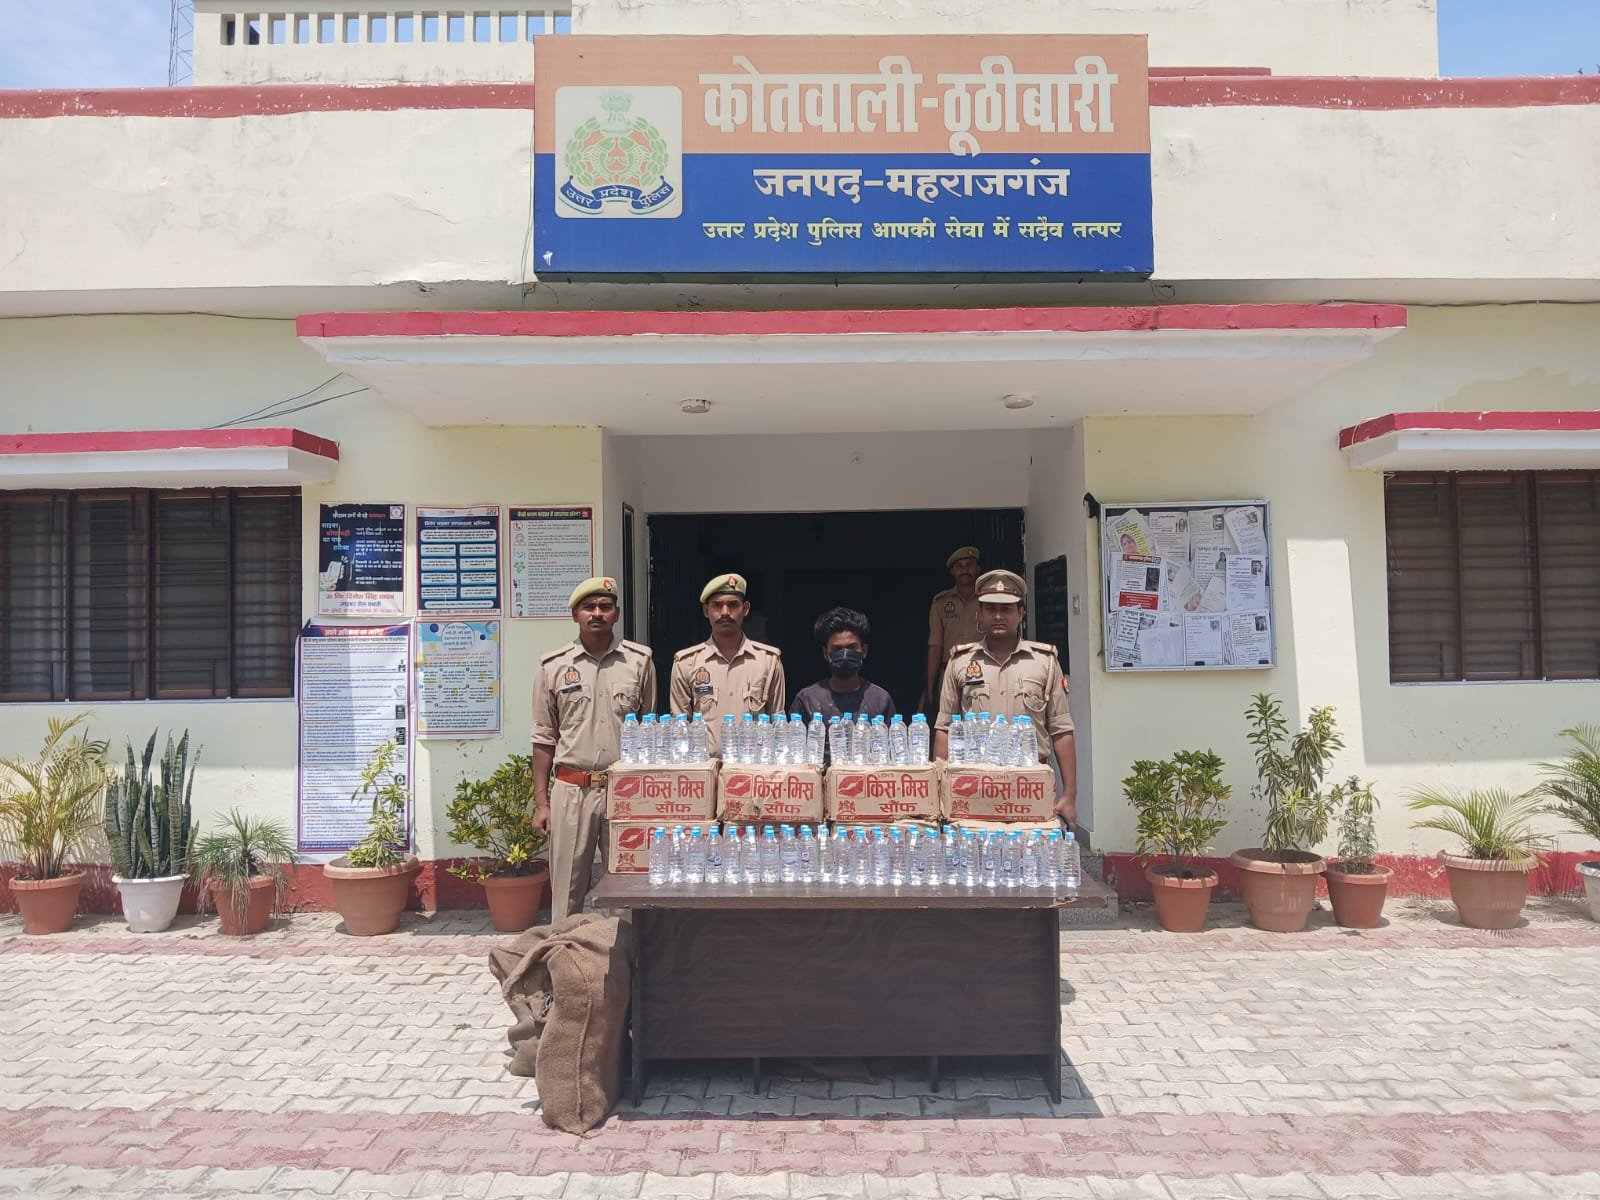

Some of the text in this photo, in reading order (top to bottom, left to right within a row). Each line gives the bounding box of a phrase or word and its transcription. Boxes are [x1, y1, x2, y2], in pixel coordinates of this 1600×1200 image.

[699, 55, 1119, 157] कोतवाली-ठूठीबारी
[565, 185, 671, 208] उत्तर प्रदेश पुलिस
[753, 157, 1071, 204] जनपद-महराजगंज
[702, 217, 1122, 246] उत्तर प्रदेश पुलिस आपकी सेवा में सदैव तत्पर
